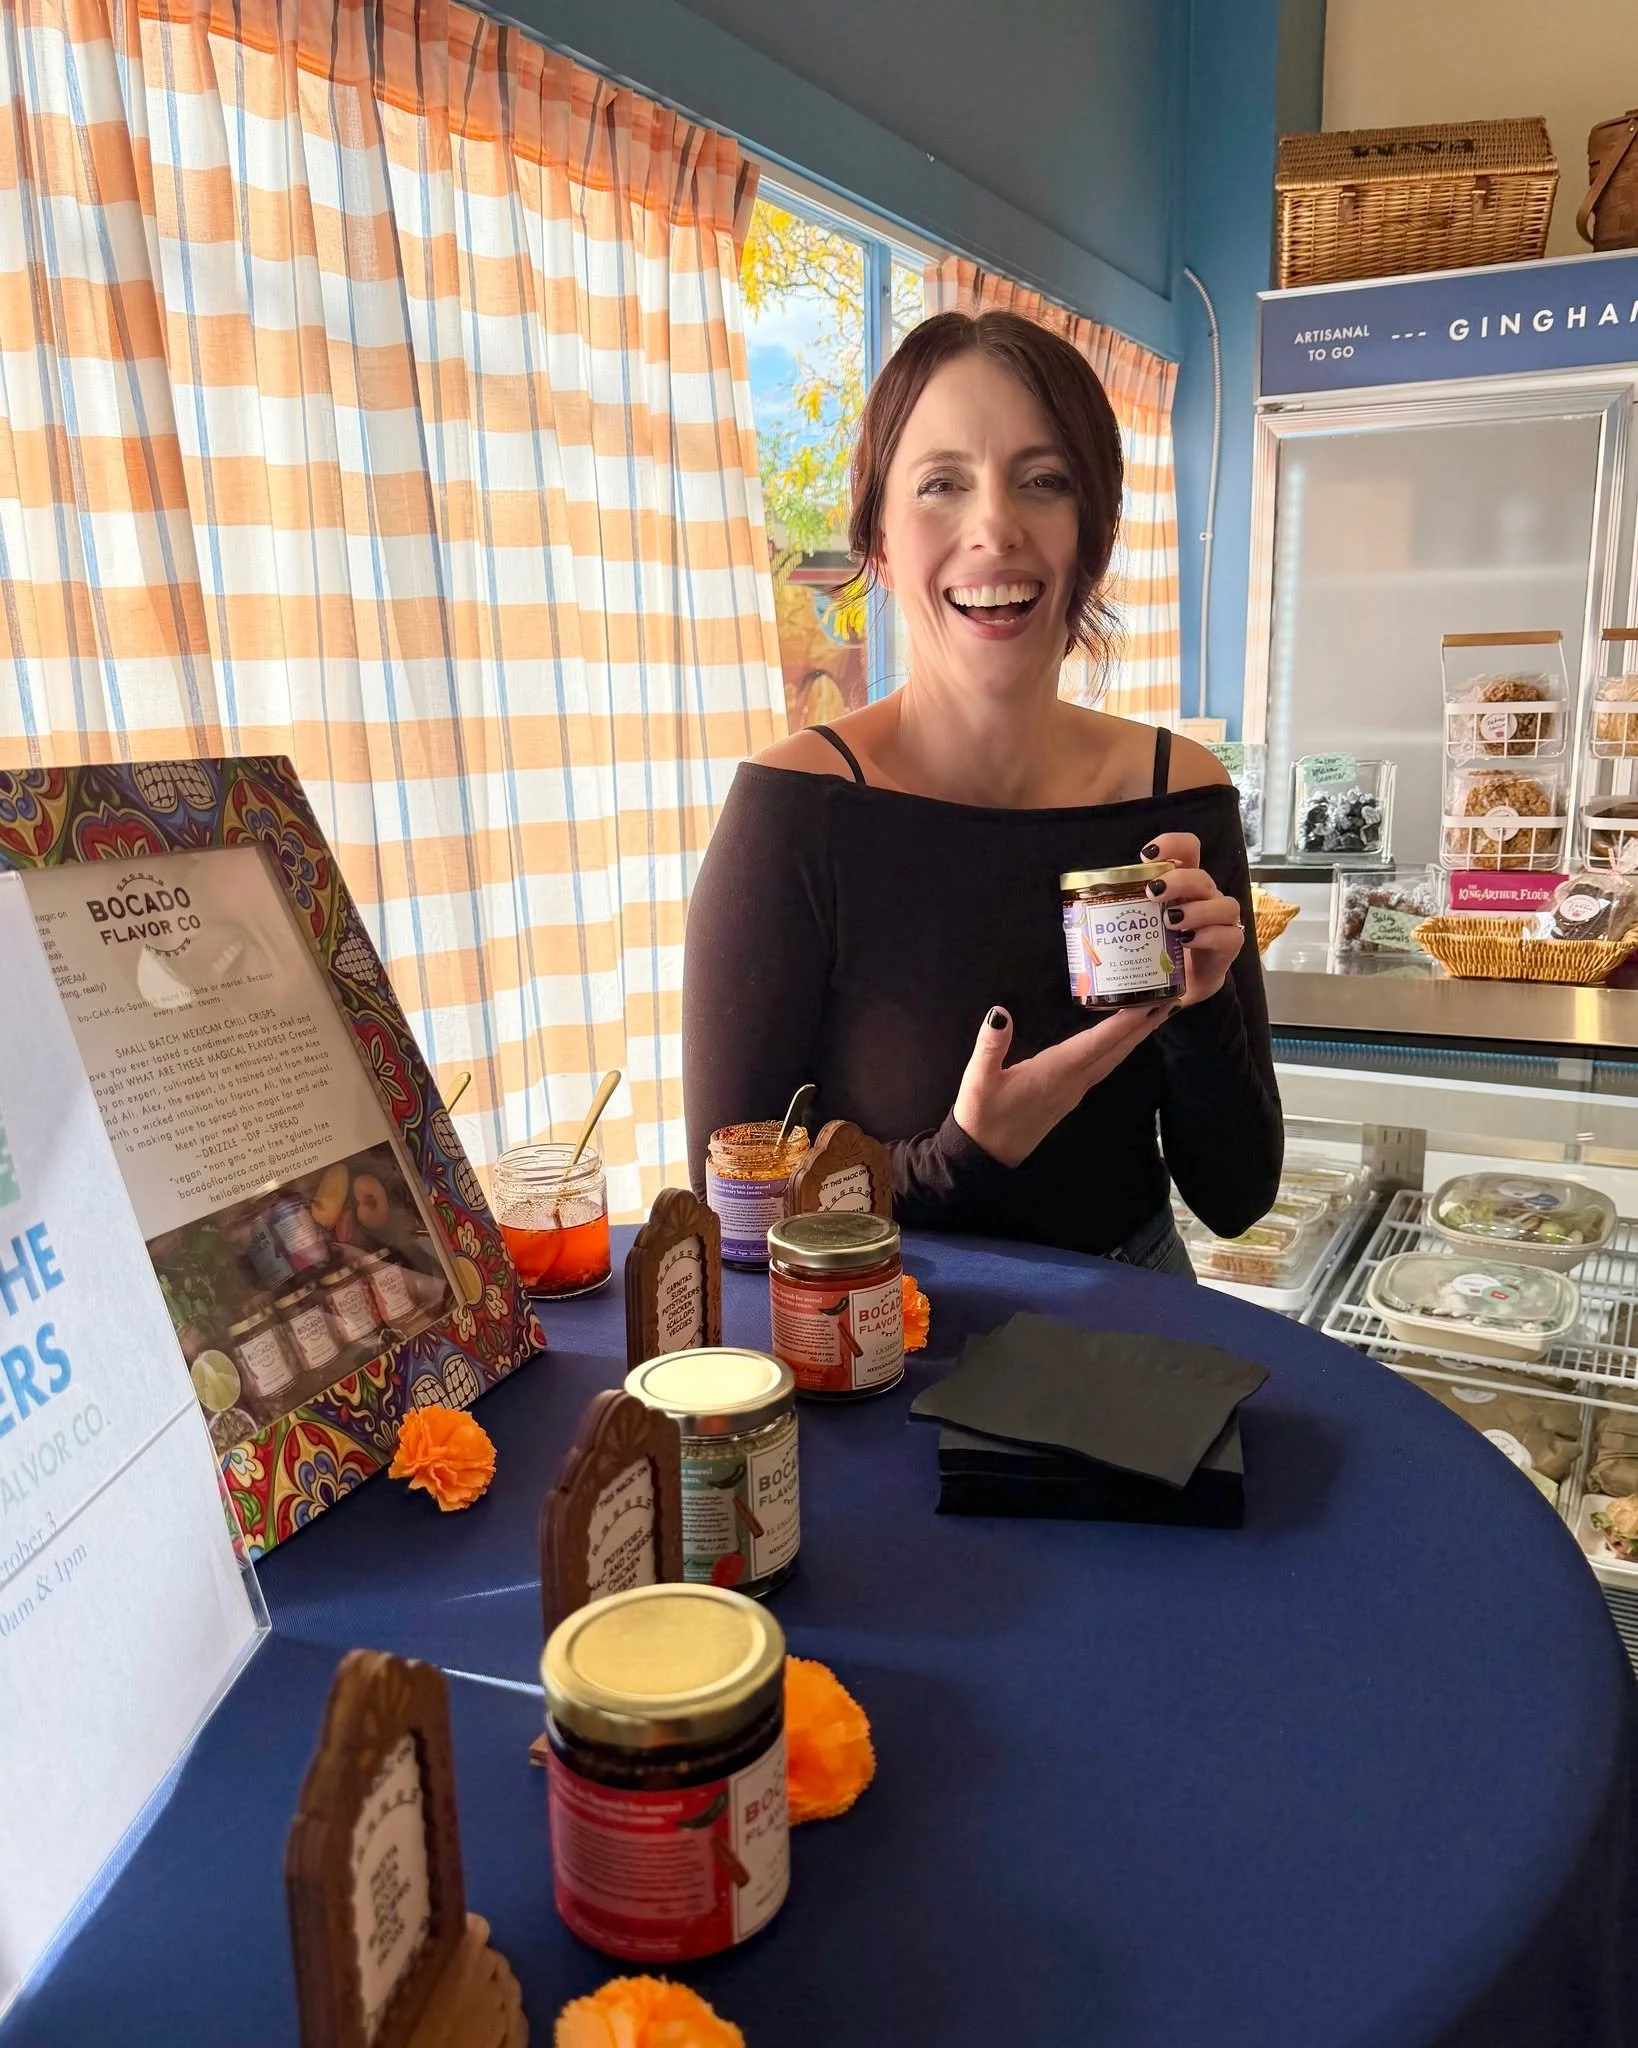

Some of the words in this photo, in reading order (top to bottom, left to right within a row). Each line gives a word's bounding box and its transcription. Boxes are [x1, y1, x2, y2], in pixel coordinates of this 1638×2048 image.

[1294, 325, 1370, 345] ARTISANAL
[1308, 349, 1326, 362] TO
[1332, 346, 1354, 360] GO
[86, 887, 191, 922] BOCADO
[1458, 888, 1482, 900] KING
[1480, 888, 1518, 900] ARTHUR
[1520, 888, 1550, 900] FLOUR
[100, 920, 172, 946] FLAVOR
[178, 914, 201, 931] CO
[1095, 916, 1160, 935] BOCADO
[1096, 934, 1141, 946] FLAVOR
[1146, 930, 1160, 940] CO
[110, 1066, 127, 1078] you
[130, 1060, 150, 1070] ever
[152, 1048, 181, 1064] tasted
[192, 1035, 236, 1054] condiment
[238, 1028, 259, 1040] made
[260, 1026, 271, 1037] by
[280, 1016, 295, 1028] chef
[297, 1012, 311, 1024] and
[114, 1042, 147, 1058] SMALL
[148, 1033, 180, 1050] BATCH
[182, 1022, 222, 1040] MEXICAN
[224, 1017, 247, 1029] CHILI
[248, 1008, 276, 1022] CRISPS
[126, 1070, 155, 1088] WHAT
[158, 1065, 176, 1078] ARE
[176, 1056, 206, 1072] THESE
[207, 1045, 247, 1064] MAGICAL
[288, 1026, 318, 1041] Created
[112, 1098, 125, 1109] an
[128, 1087, 161, 1104] expert,
[163, 1073, 206, 1092] cultivated
[208, 1070, 219, 1080] by
[221, 1066, 232, 1074] an
[234, 1052, 278, 1071] enthusiast,
[280, 1048, 289, 1058] we
[291, 1044, 303, 1054] are
[305, 1039, 321, 1049] Alex
[142, 1104, 166, 1115] Alex,
[167, 1096, 183, 1107] the
[185, 1086, 216, 1102] expert,
[218, 1082, 226, 1090] is
[236, 1070, 265, 1084] trained
[266, 1064, 284, 1076] chef
[284, 1060, 302, 1070] from
[304, 1050, 329, 1064] Mexico
[109, 1128, 130, 1142] with
[142, 1114, 174, 1131] wicked
[176, 1101, 214, 1119] intuition
[215, 1096, 228, 1106] for
[230, 1086, 263, 1102] flavors.
[280, 1077, 292, 1086] the
[294, 1064, 333, 1082] enthusiast,
[126, 1144, 135, 1152] is
[137, 1132, 173, 1150] making
[174, 1124, 194, 1137] sure
[196, 1120, 206, 1128] to
[208, 1108, 238, 1126] spread
[240, 1104, 256, 1114] this
[257, 1095, 281, 1109] magic
[282, 1092, 294, 1100] far
[296, 1086, 310, 1095] and
[312, 1079, 328, 1089] wide
[175, 1138, 198, 1152] Meet
[200, 1132, 219, 1146] your
[222, 1124, 240, 1136] next
[242, 1120, 253, 1130] go
[254, 1116, 264, 1124] to
[265, 1101, 305, 1120] condiment
[228, 1153, 246, 1166] gmo
[268, 1138, 284, 1150] free
[314, 1120, 330, 1132] free
[178, 1160, 266, 1200] bocadoflavorco.com
[268, 1134, 334, 1166] @bocadoflavorco
[209, 1154, 319, 1204] hello@bocadoflavorco.com
[830, 1178, 842, 1188] THIS
[842, 1172, 858, 1182] MAGIC
[666, 1272, 692, 1294] CARNITAS
[672, 1285, 688, 1300] SUSHI
[662, 1286, 700, 1316] POTSTICKERS
[668, 1300, 692, 1320] CHICKEN
[858, 1296, 902, 1322] BOCAD
[666, 1306, 696, 1332] SCALLOPS
[669, 1317, 692, 1338] VEGGIES
[859, 1313, 897, 1335] FLAVOR
[72, 1403, 112, 1446] CO.
[46, 1512, 57, 1536] 3
[603, 1526, 643, 1568] POTATOES
[36, 1574, 54, 1601] &
[54, 1544, 88, 1584] 1pm
